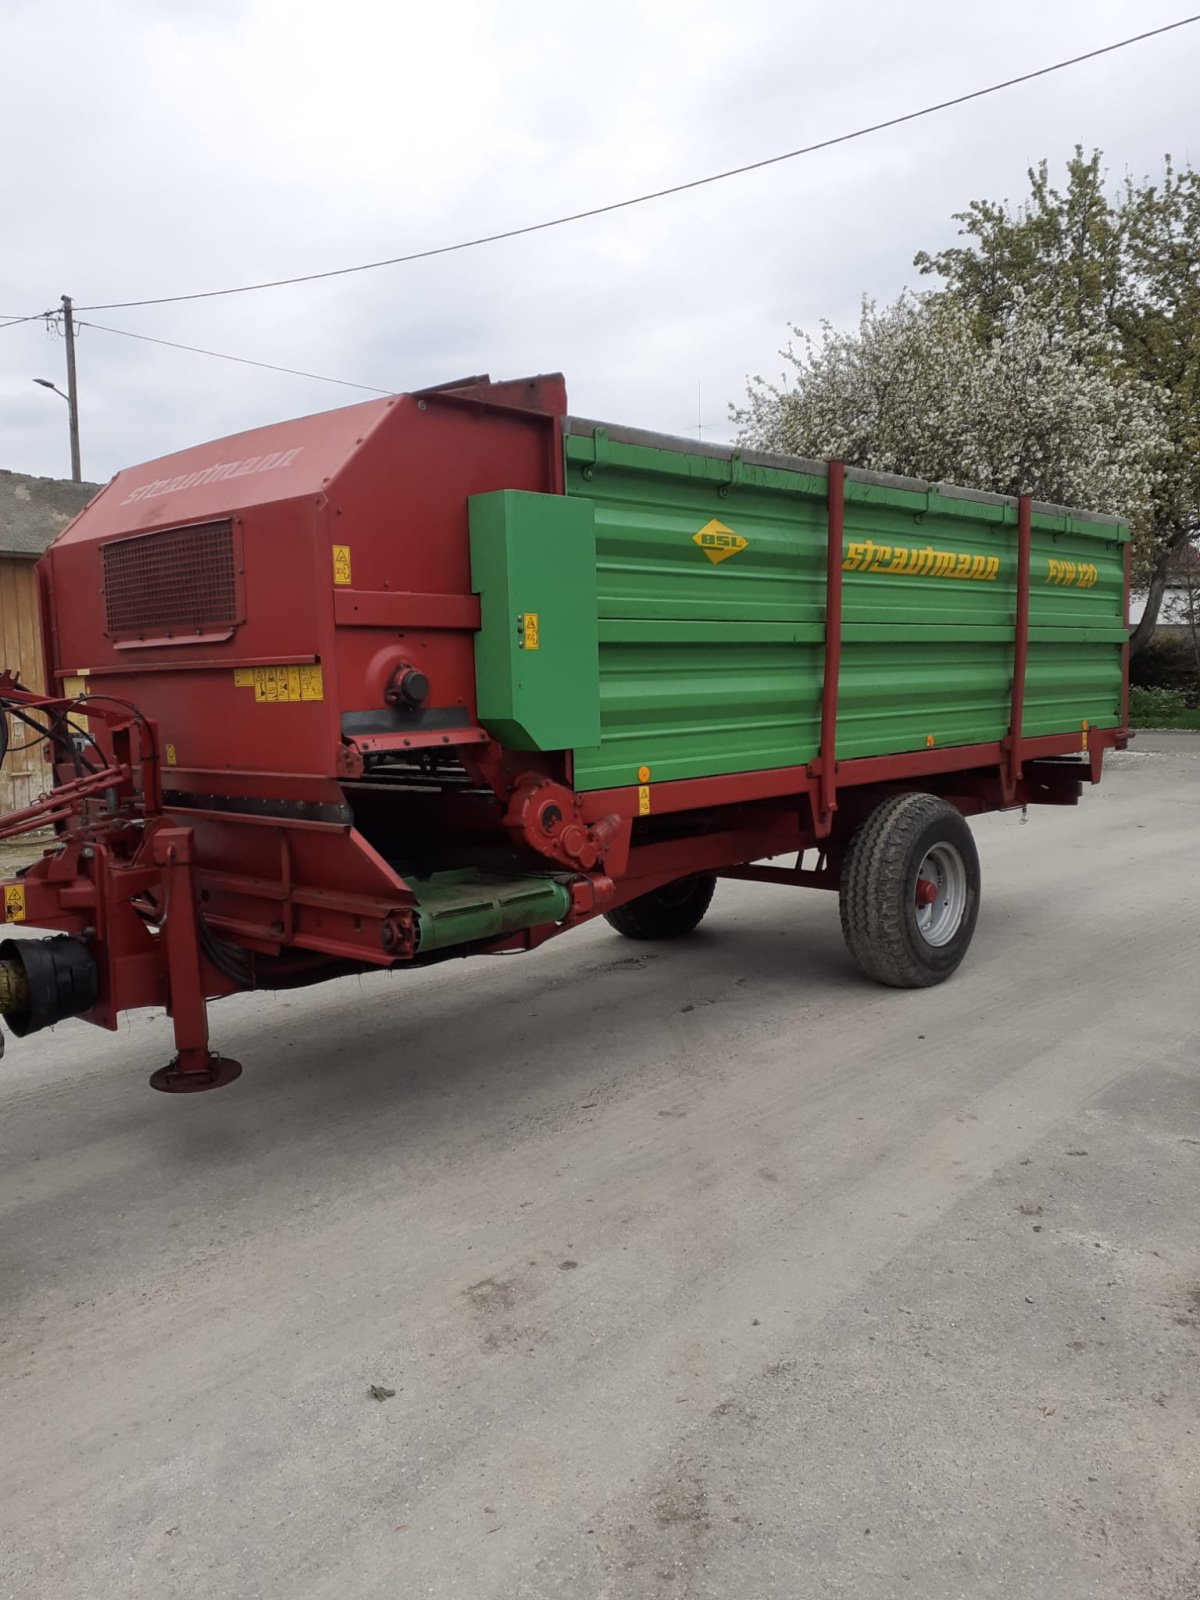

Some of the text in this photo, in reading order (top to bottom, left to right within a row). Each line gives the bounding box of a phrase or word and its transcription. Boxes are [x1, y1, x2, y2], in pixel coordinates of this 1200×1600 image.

[701, 534, 742, 547] BSL
[1045, 559, 1097, 588] FVW 120
